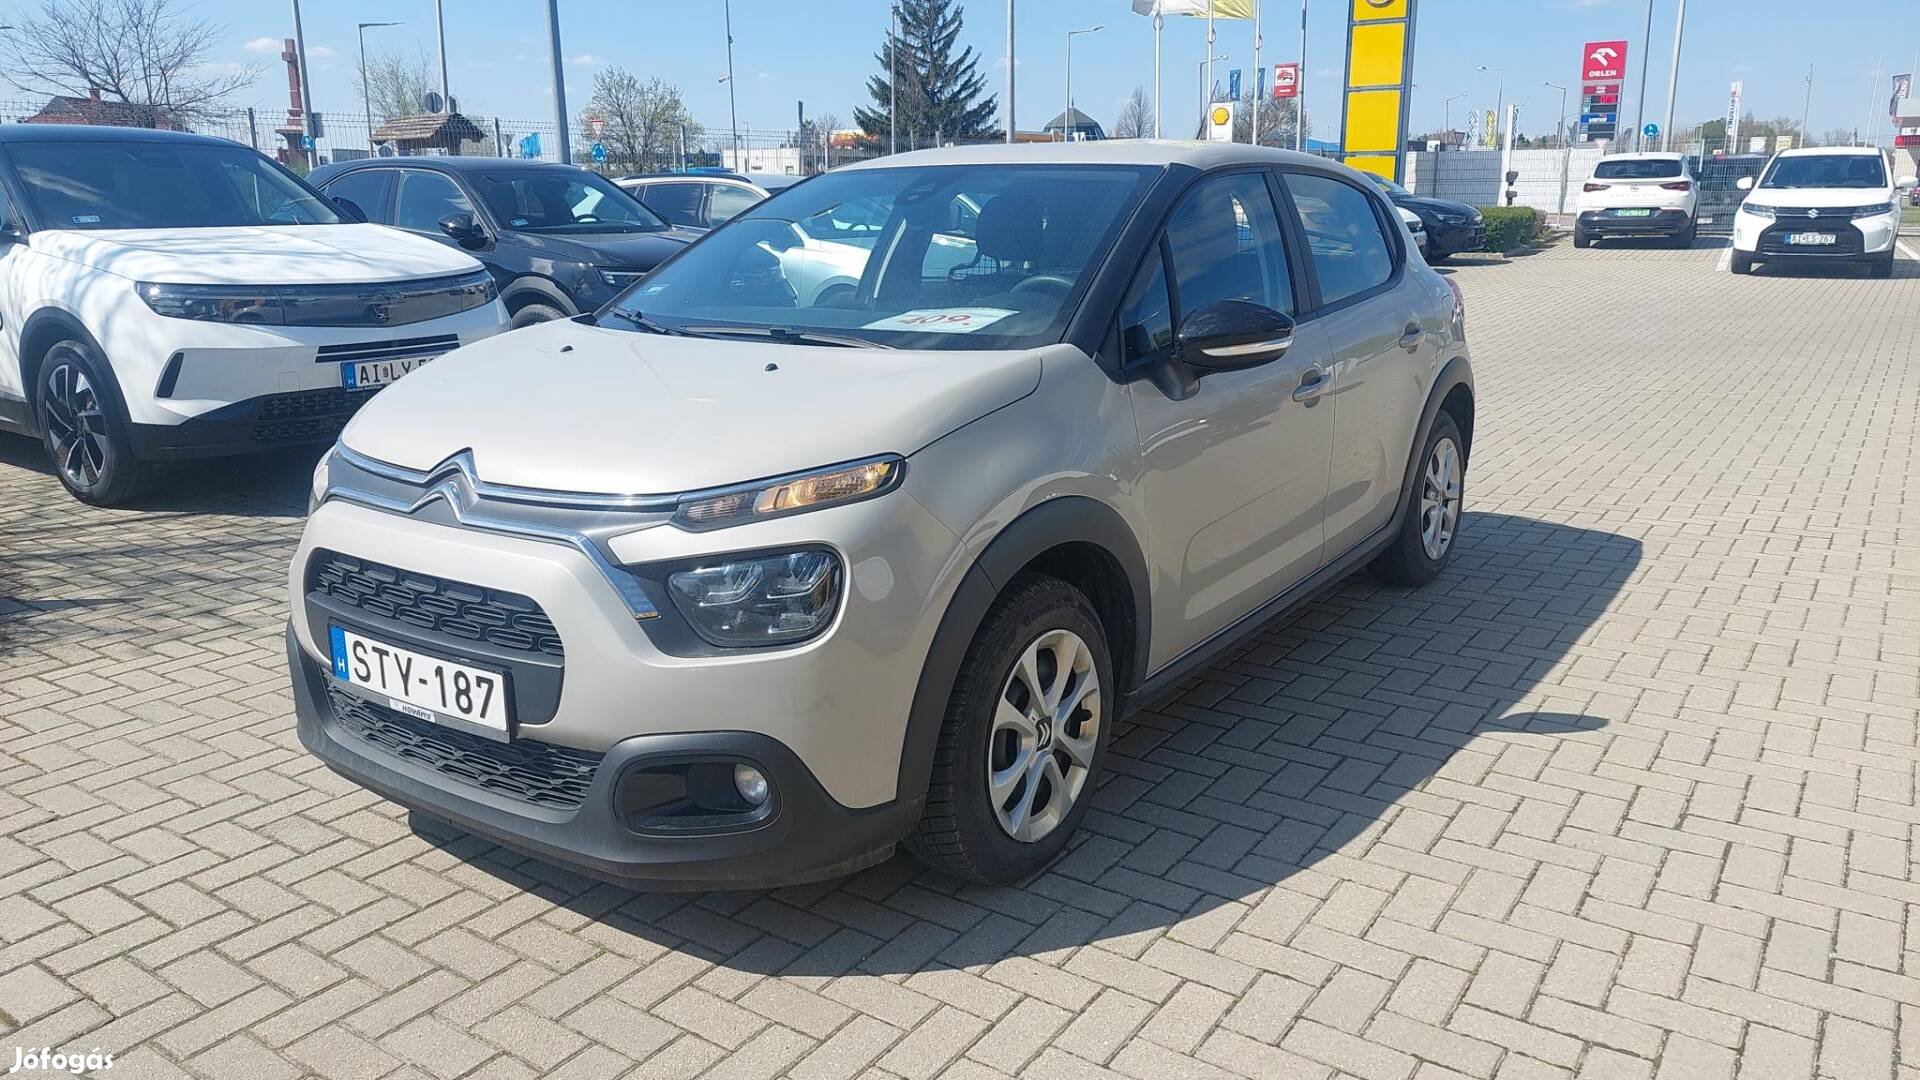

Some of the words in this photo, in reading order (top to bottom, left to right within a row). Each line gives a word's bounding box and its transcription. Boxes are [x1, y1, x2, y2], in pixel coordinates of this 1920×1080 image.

[1588, 69, 1617, 78] ORLEN
[360, 364, 380, 384] AI
[337, 658, 346, 673] H
[352, 640, 494, 719] STY-187
